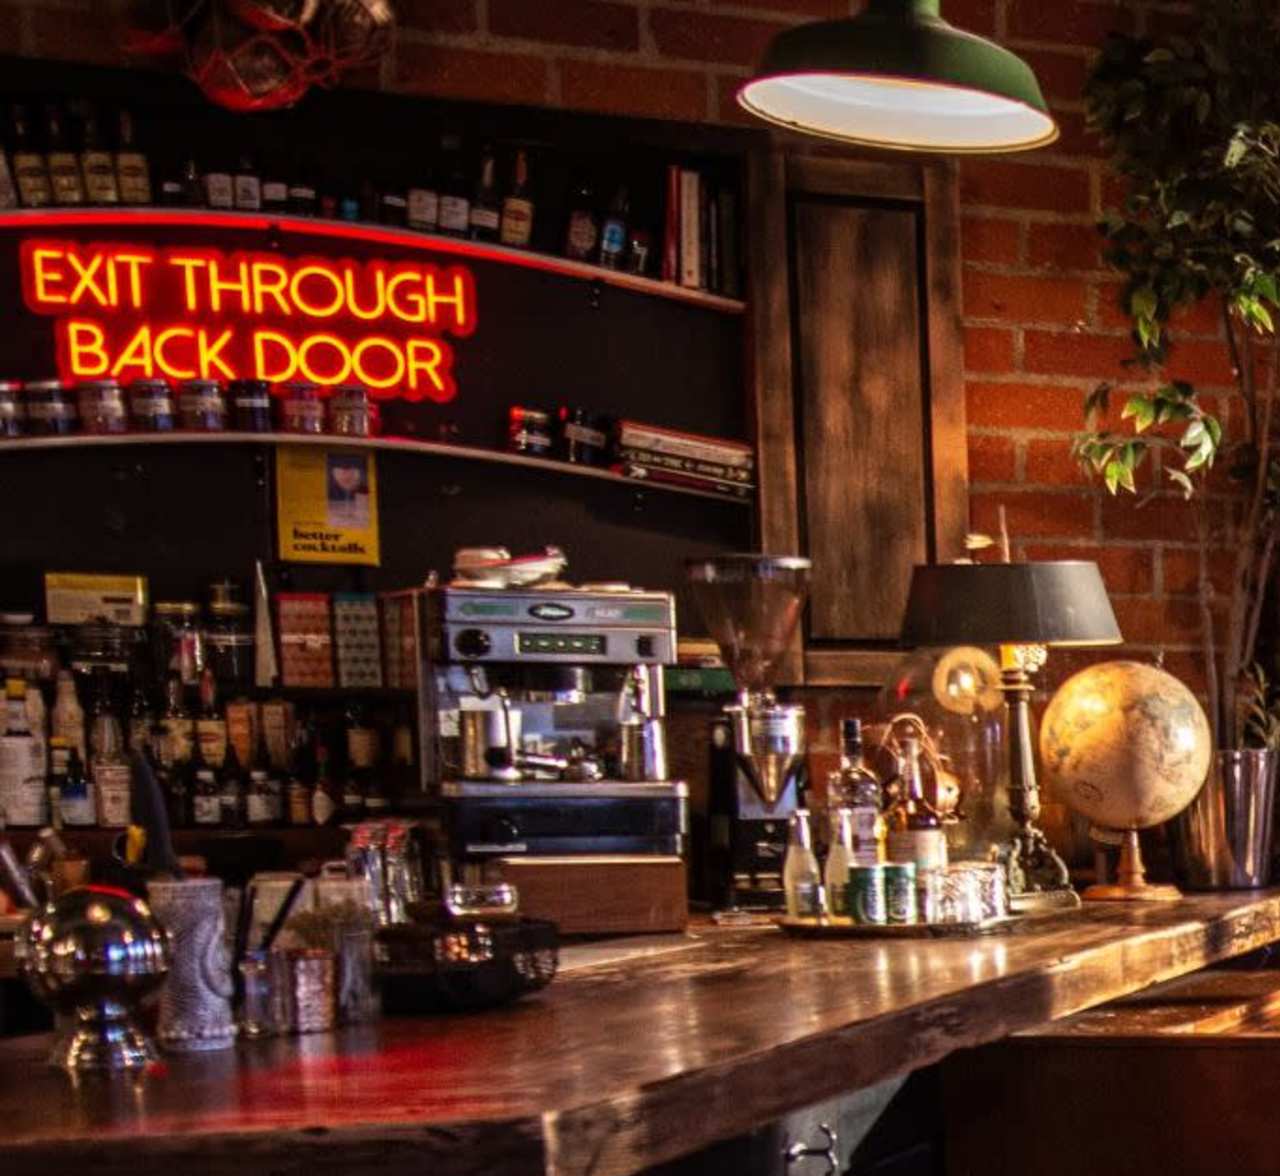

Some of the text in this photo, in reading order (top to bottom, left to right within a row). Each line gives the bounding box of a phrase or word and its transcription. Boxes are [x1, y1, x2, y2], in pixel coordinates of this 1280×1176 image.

[33, 249, 467, 328] EXIT THROUGH
[68, 322, 446, 392] BACK DOOR
